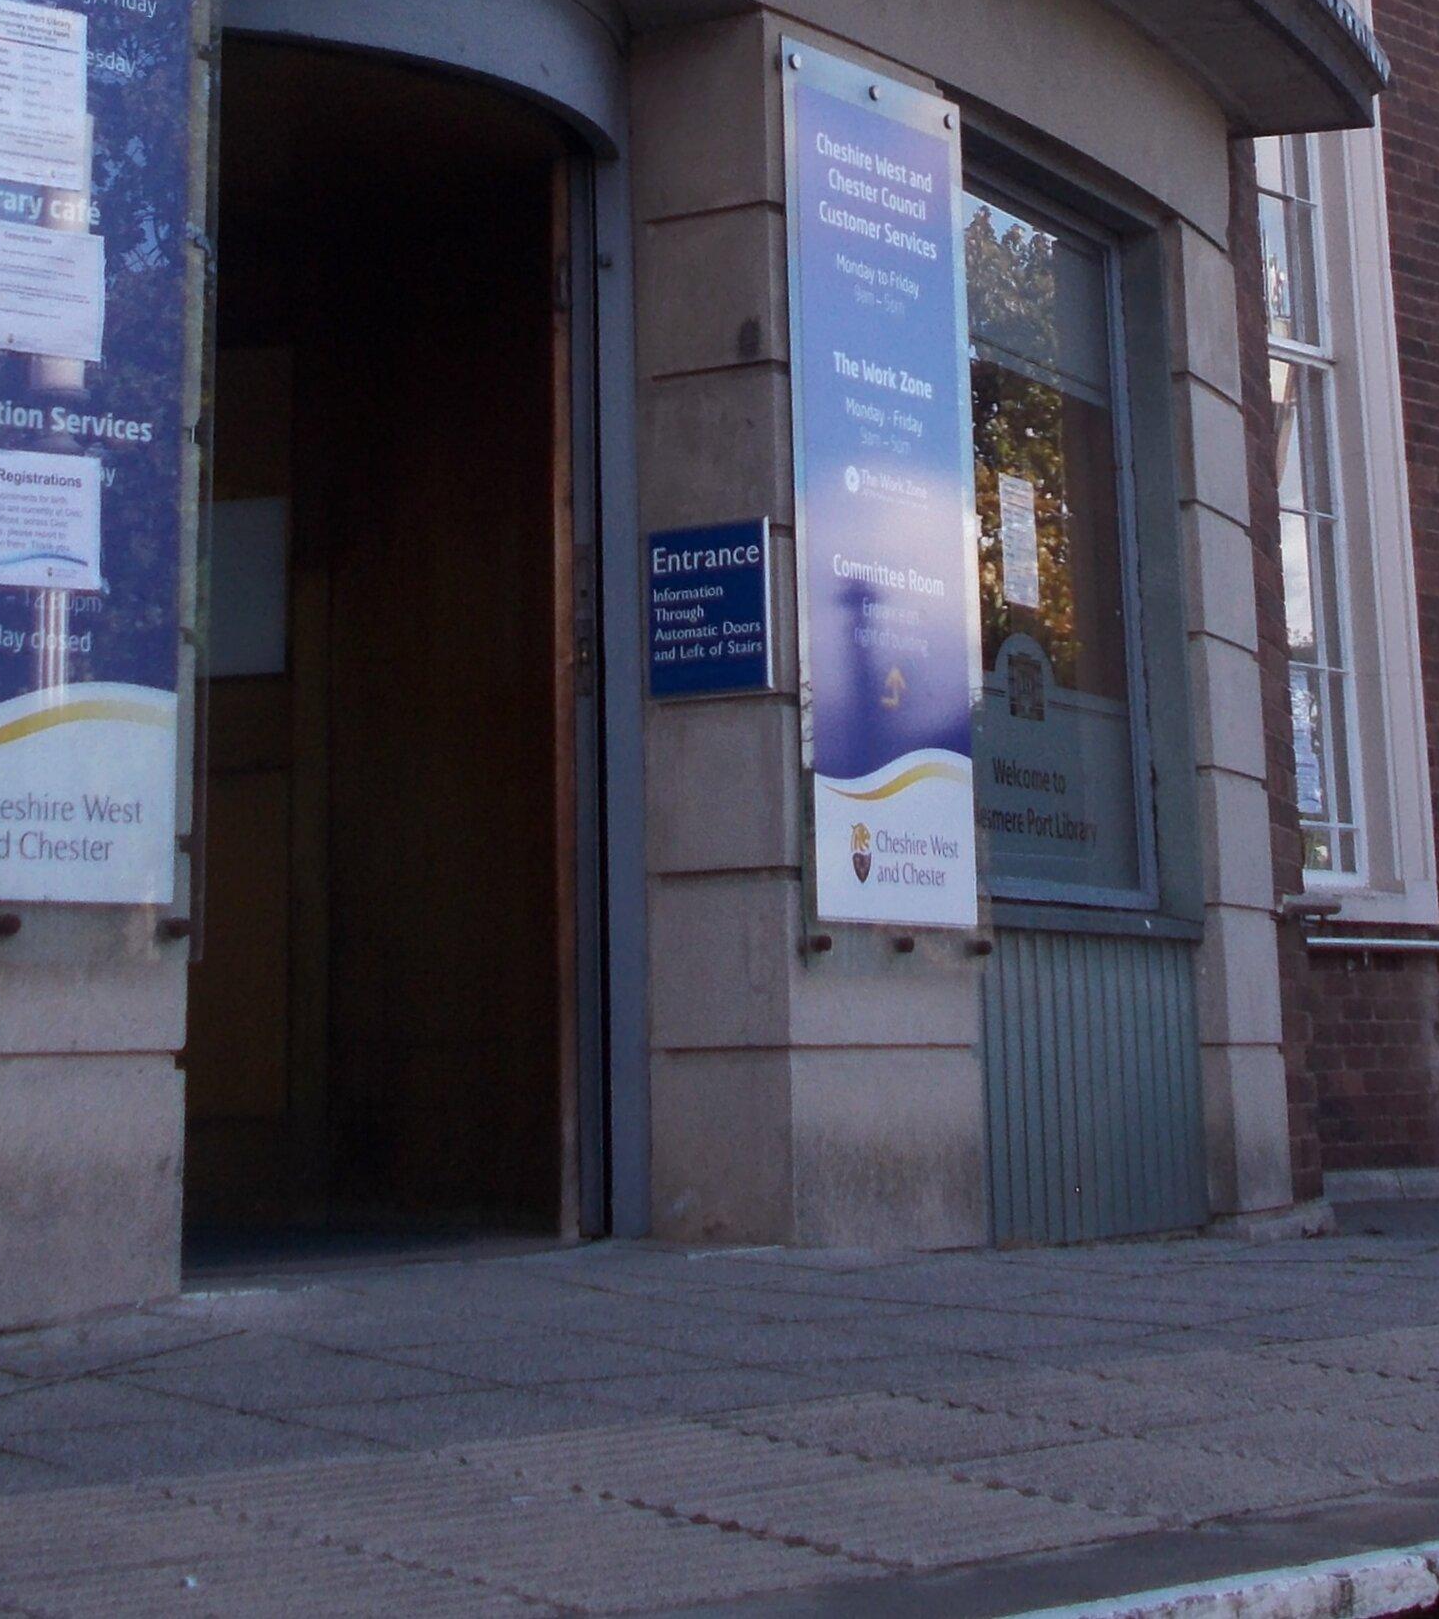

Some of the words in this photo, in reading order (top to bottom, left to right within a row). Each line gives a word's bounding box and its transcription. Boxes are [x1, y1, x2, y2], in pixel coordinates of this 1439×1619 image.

[86, 47, 137, 80] esday
[816, 132, 872, 171] Cheshire
[875, 154, 906, 183] West
[910, 170, 932, 193] and
[828, 167, 878, 203] Chester
[881, 186, 926, 220] Council
[818, 200, 880, 239] Customer
[884, 222, 937, 260] Services
[836, 253, 875, 286] Monday
[877, 267, 888, 286] to
[890, 270, 920, 300] Friday
[833, 351, 858, 378] The
[862, 359, 896, 391] Work
[899, 371, 932, 399] Zone
[50, 406, 153, 442] Services
[846, 396, 885, 428] Monday
[893, 409, 923, 438] Friday
[652, 544, 760, 574] Entrance
[833, 553, 906, 590] Committee
[909, 568, 945, 596] Room
[654, 585, 724, 603] Information
[655, 605, 705, 623] Through
[654, 624, 718, 642] Automatic
[722, 621, 761, 636] Doors
[654, 646, 676, 662] and
[680, 643, 705, 660] Left
[709, 641, 723, 657] of
[727, 639, 762, 655] Stairs
[992, 756, 1050, 792] Welcome
[1053, 770, 1067, 795] to
[83, 794, 143, 823] West
[1027, 807, 1054, 838] Port
[18, 833, 114, 862] Chester
[876, 830, 927, 858] Cheshire
[929, 834, 959, 859] West
[877, 863, 900, 884] and
[902, 862, 946, 888] Chester
